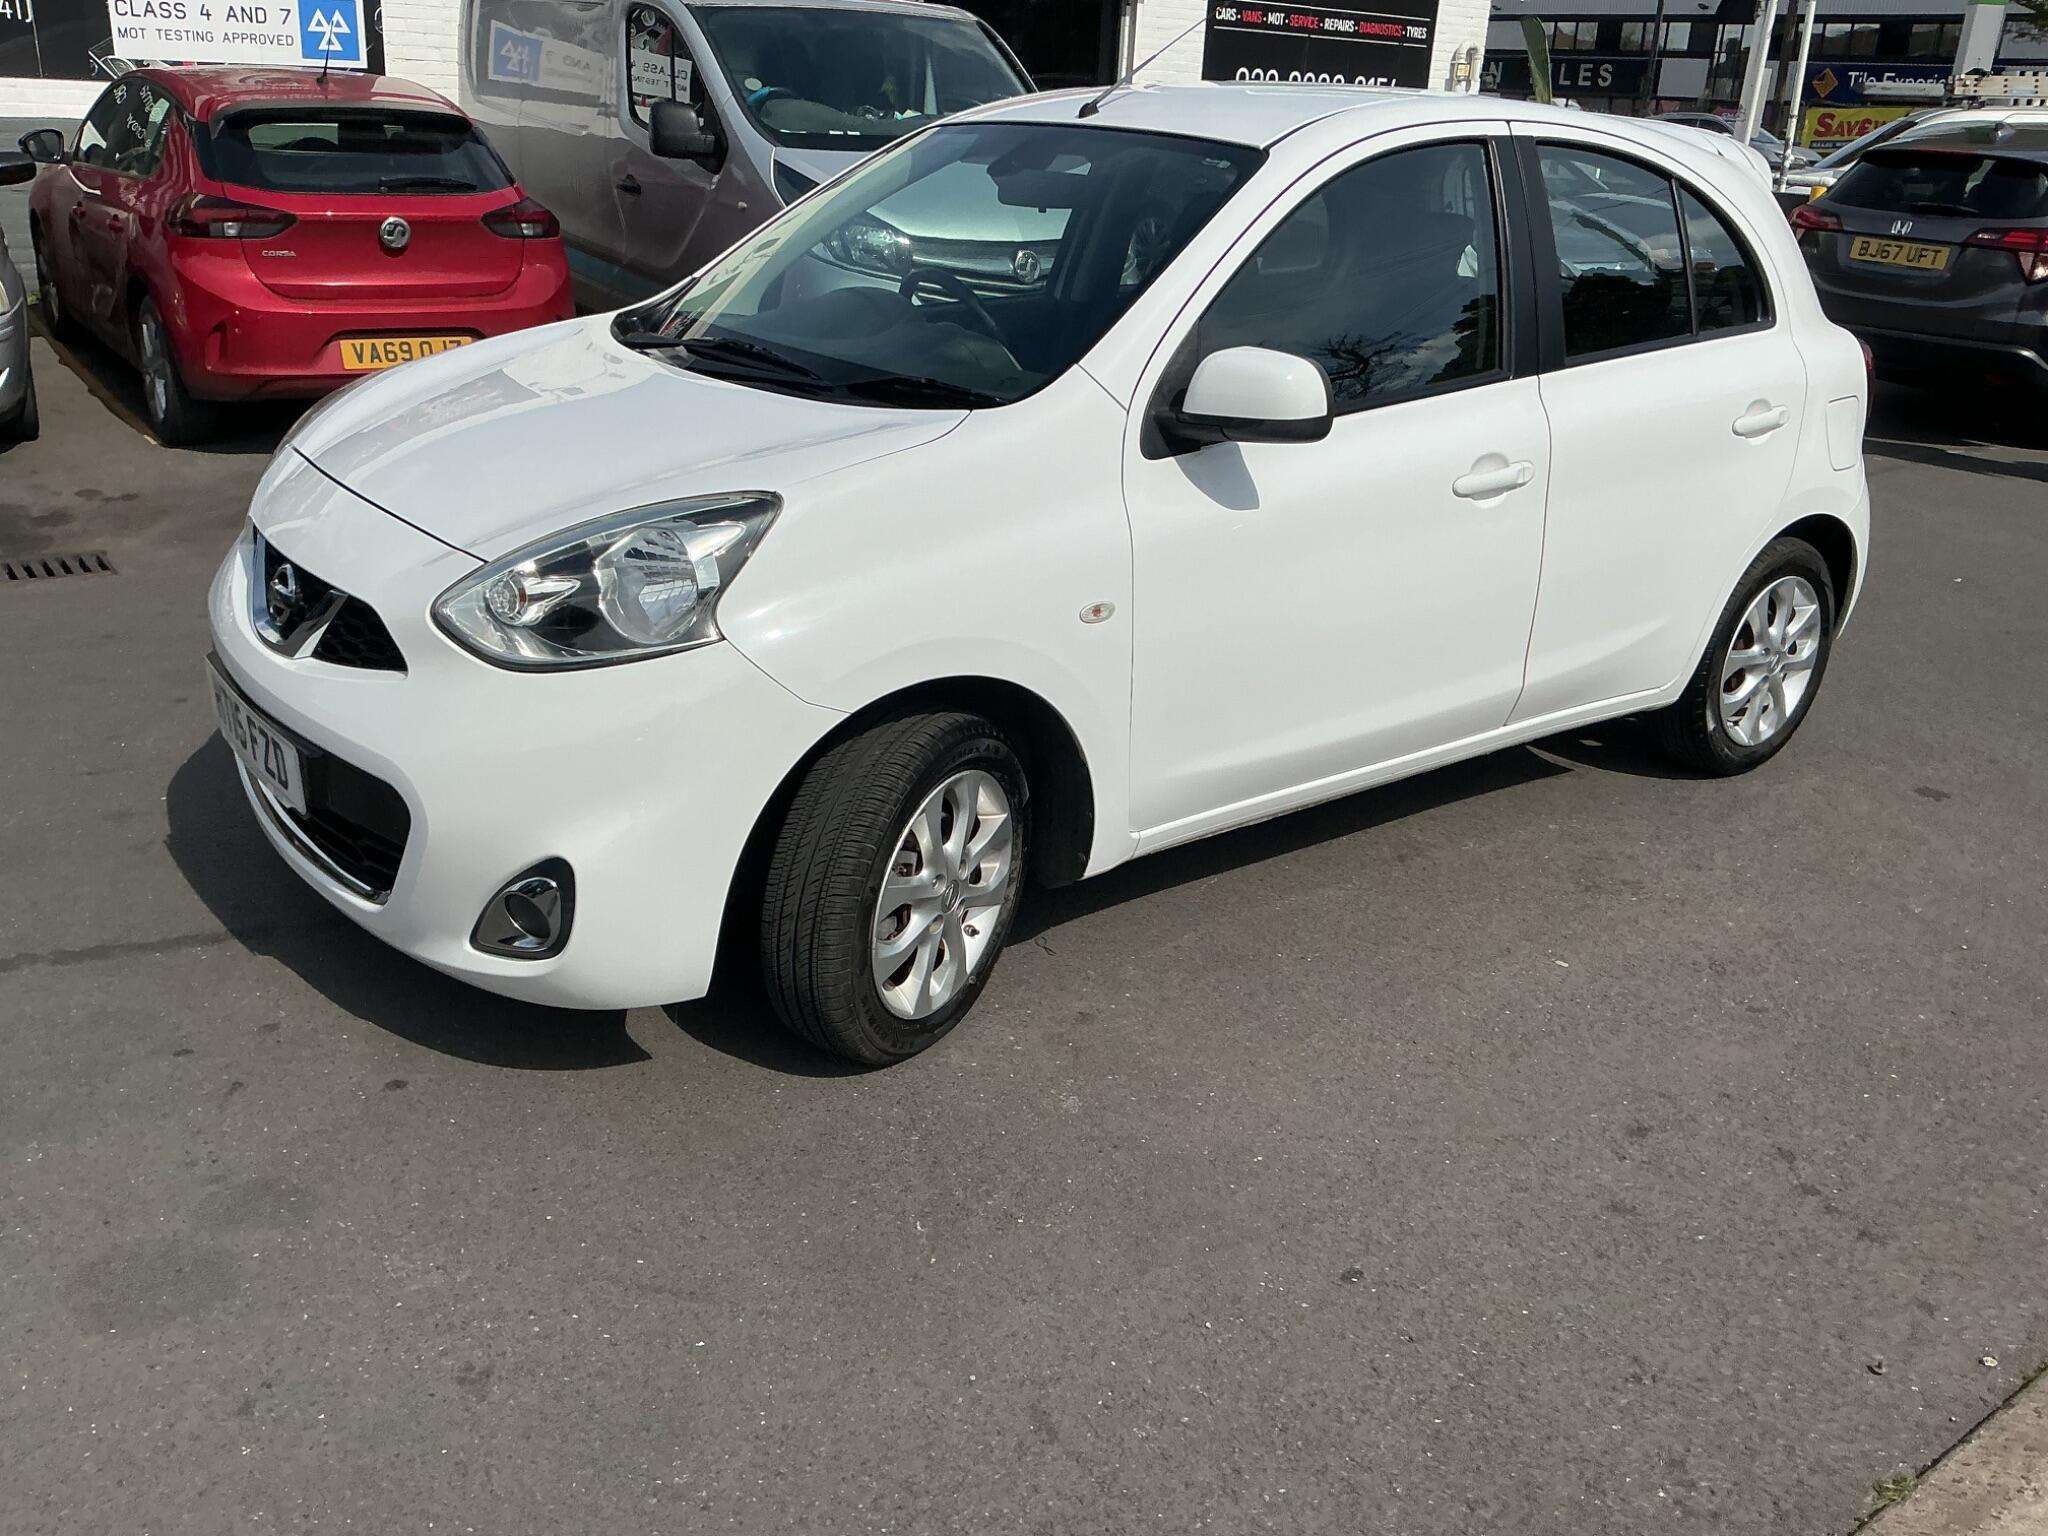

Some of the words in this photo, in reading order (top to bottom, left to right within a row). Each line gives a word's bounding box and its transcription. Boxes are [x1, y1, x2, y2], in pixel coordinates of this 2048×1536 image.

[115, 0, 187, 20] CLASS
[199, 8, 212, 21] 4
[226, 6, 267, 24] AND
[279, 8, 292, 25] 7
[1215, 7, 1236, 21] CARS
[1241, 10, 1263, 23] VANS
[1267, 12, 1284, 26] MOT
[1289, 14, 1319, 29] SERVICE
[1324, 18, 1355, 32] REPAIRS
[1359, 21, 1402, 37] DIAGNOSTICS
[1406, 26, 1428, 39] TYRES
[117, 27, 147, 40] MOT
[155, 28, 214, 43] TESTING
[222, 32, 294, 47] APPROVED
[1857, 240, 1904, 261] BJ67
[1905, 246, 1943, 266] UFT
[351, 342, 414, 364] VA69
[246, 714, 289, 791] FZD
